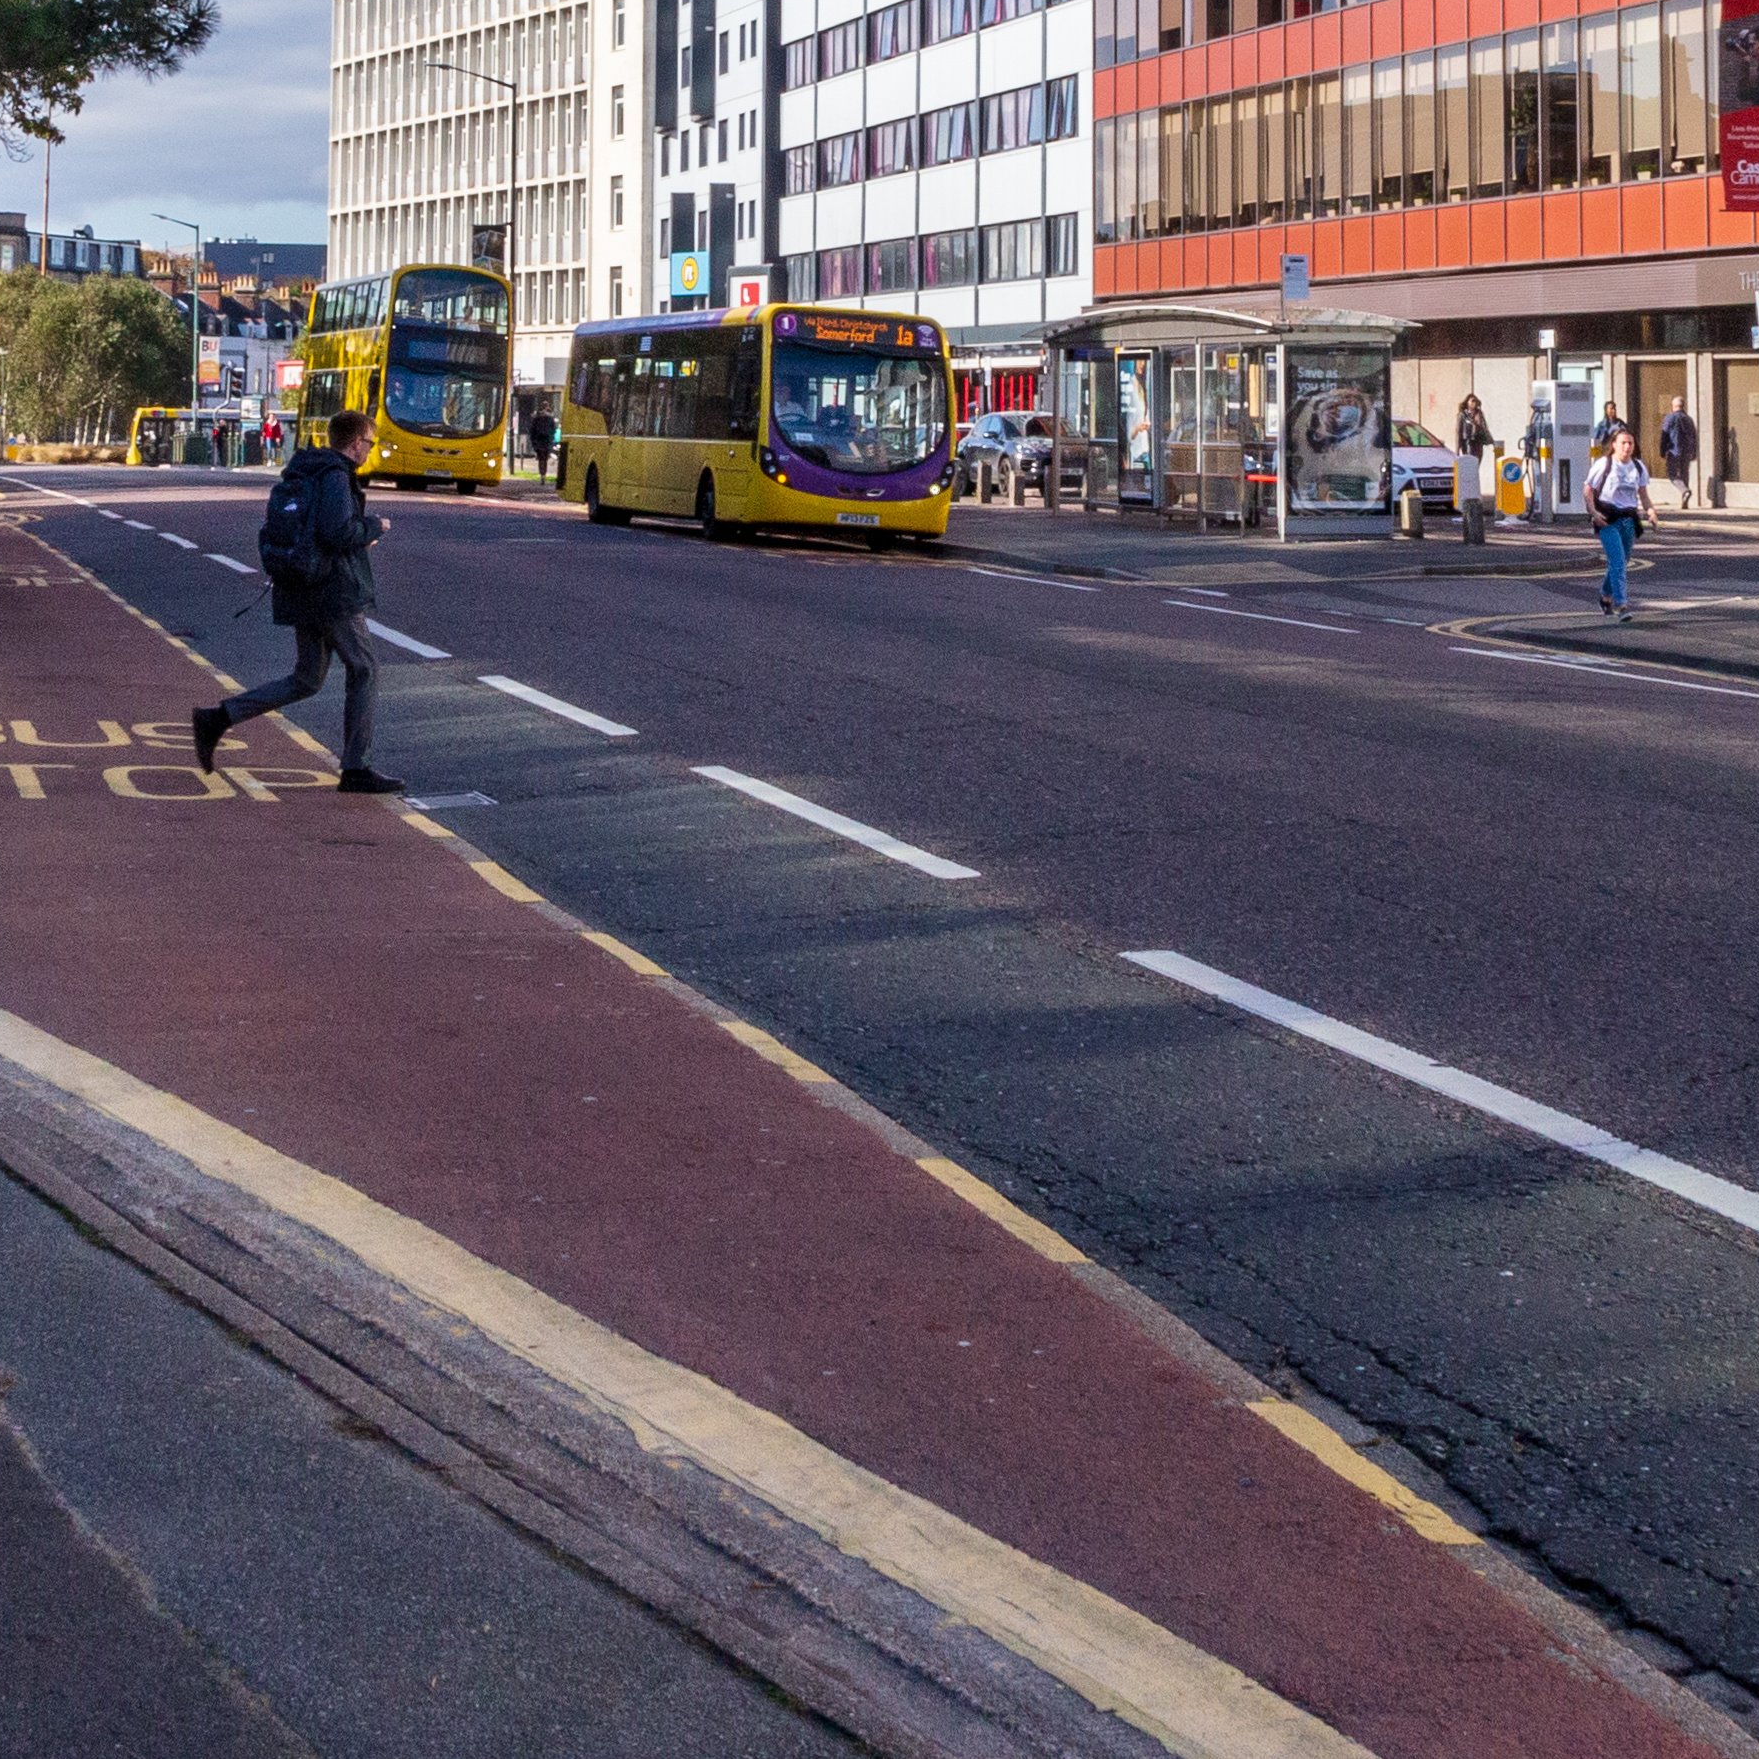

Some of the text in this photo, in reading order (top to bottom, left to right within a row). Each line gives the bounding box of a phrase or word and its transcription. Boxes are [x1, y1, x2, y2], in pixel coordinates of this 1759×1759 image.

[815, 327, 876, 343] Somerford
[896, 324, 915, 348] 1a
[201, 340, 218, 353] BU
[1297, 365, 1339, 379] Save as
